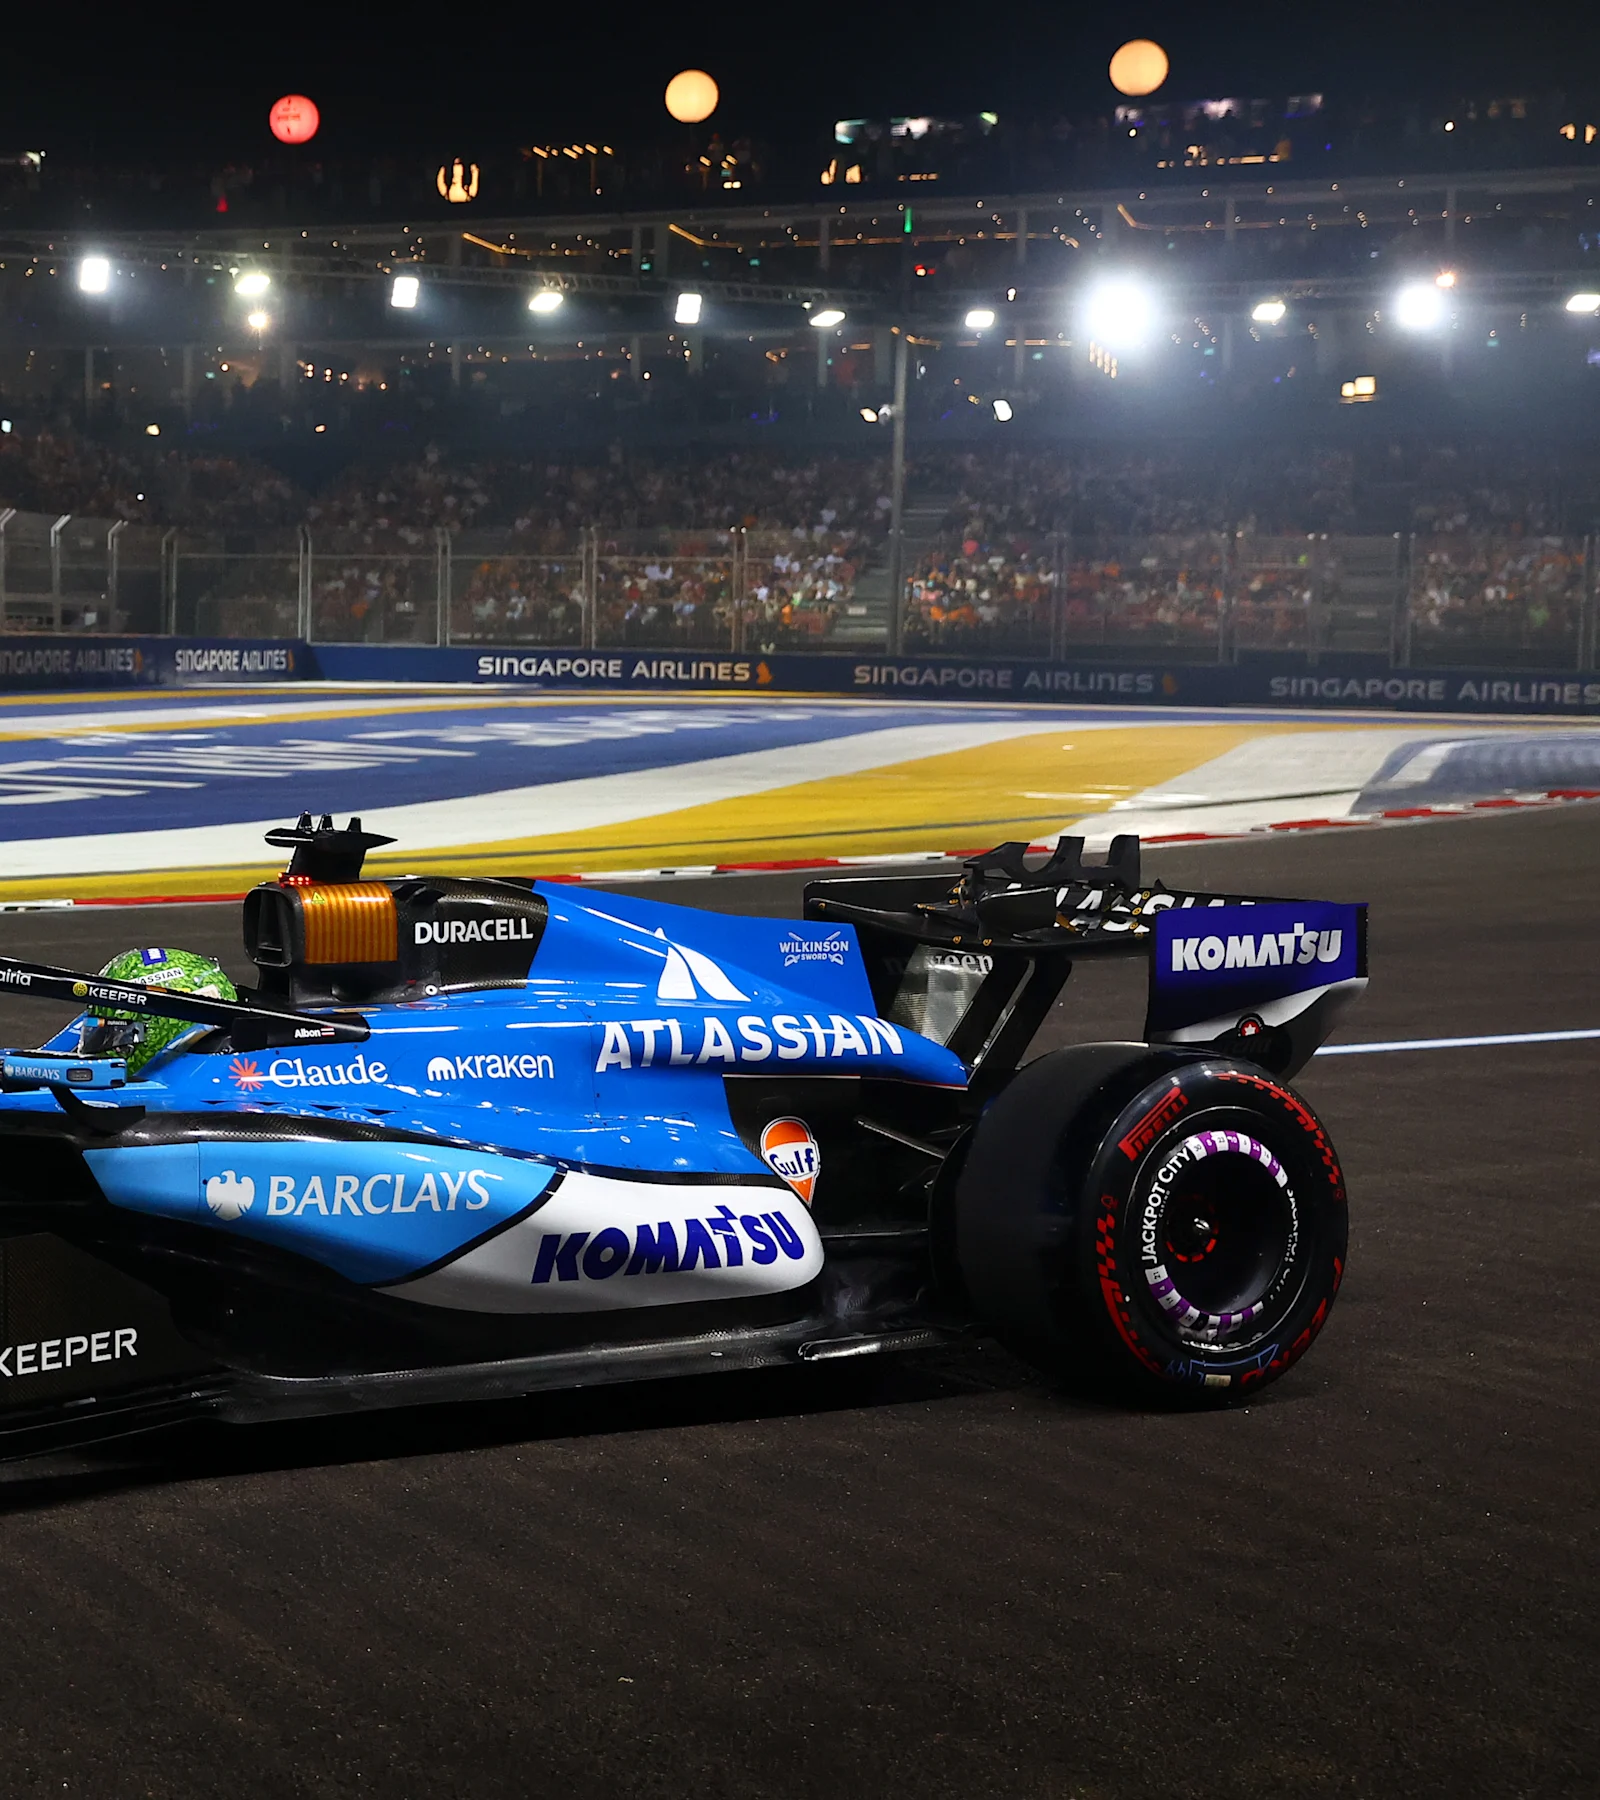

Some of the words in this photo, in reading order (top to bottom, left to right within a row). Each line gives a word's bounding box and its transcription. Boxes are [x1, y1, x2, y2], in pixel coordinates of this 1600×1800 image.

[74, 649, 134, 673] AIRLINES
[174, 649, 239, 672] SINGAPORE
[241, 649, 287, 672] AIRLINES
[477, 656, 622, 679] SINGAPORE
[631, 661, 750, 682] AIRLINES
[853, 664, 1013, 689] SINGAPORE
[1023, 667, 1155, 694] AIRLINES
[1269, 676, 1445, 700] SINGAPORE
[1457, 680, 1600, 706] AIRLINES
[414, 917, 534, 945] DURACELL
[779, 940, 849, 953] WILKINSON
[800, 953, 828, 961] SWORD
[1171, 922, 1343, 972] KOMATSU
[134, 968, 183, 985] ASSIAN
[88, 985, 148, 1006] KEEPER
[294, 1027, 321, 1039] Albon
[595, 1013, 904, 1074] ATLASSIAN
[14, 1065, 60, 1081] BARCLAYS
[268, 1054, 389, 1088] Claude
[1117, 1086, 1189, 1162] PIRELLI
[769, 1147, 816, 1179] Gulf
[266, 1168, 491, 1217] BARCLAYS
[1141, 1181, 1167, 1264] JACKPOT
[1157, 1146, 1192, 1184] CITY
[531, 1204, 805, 1284] KOMATSU
